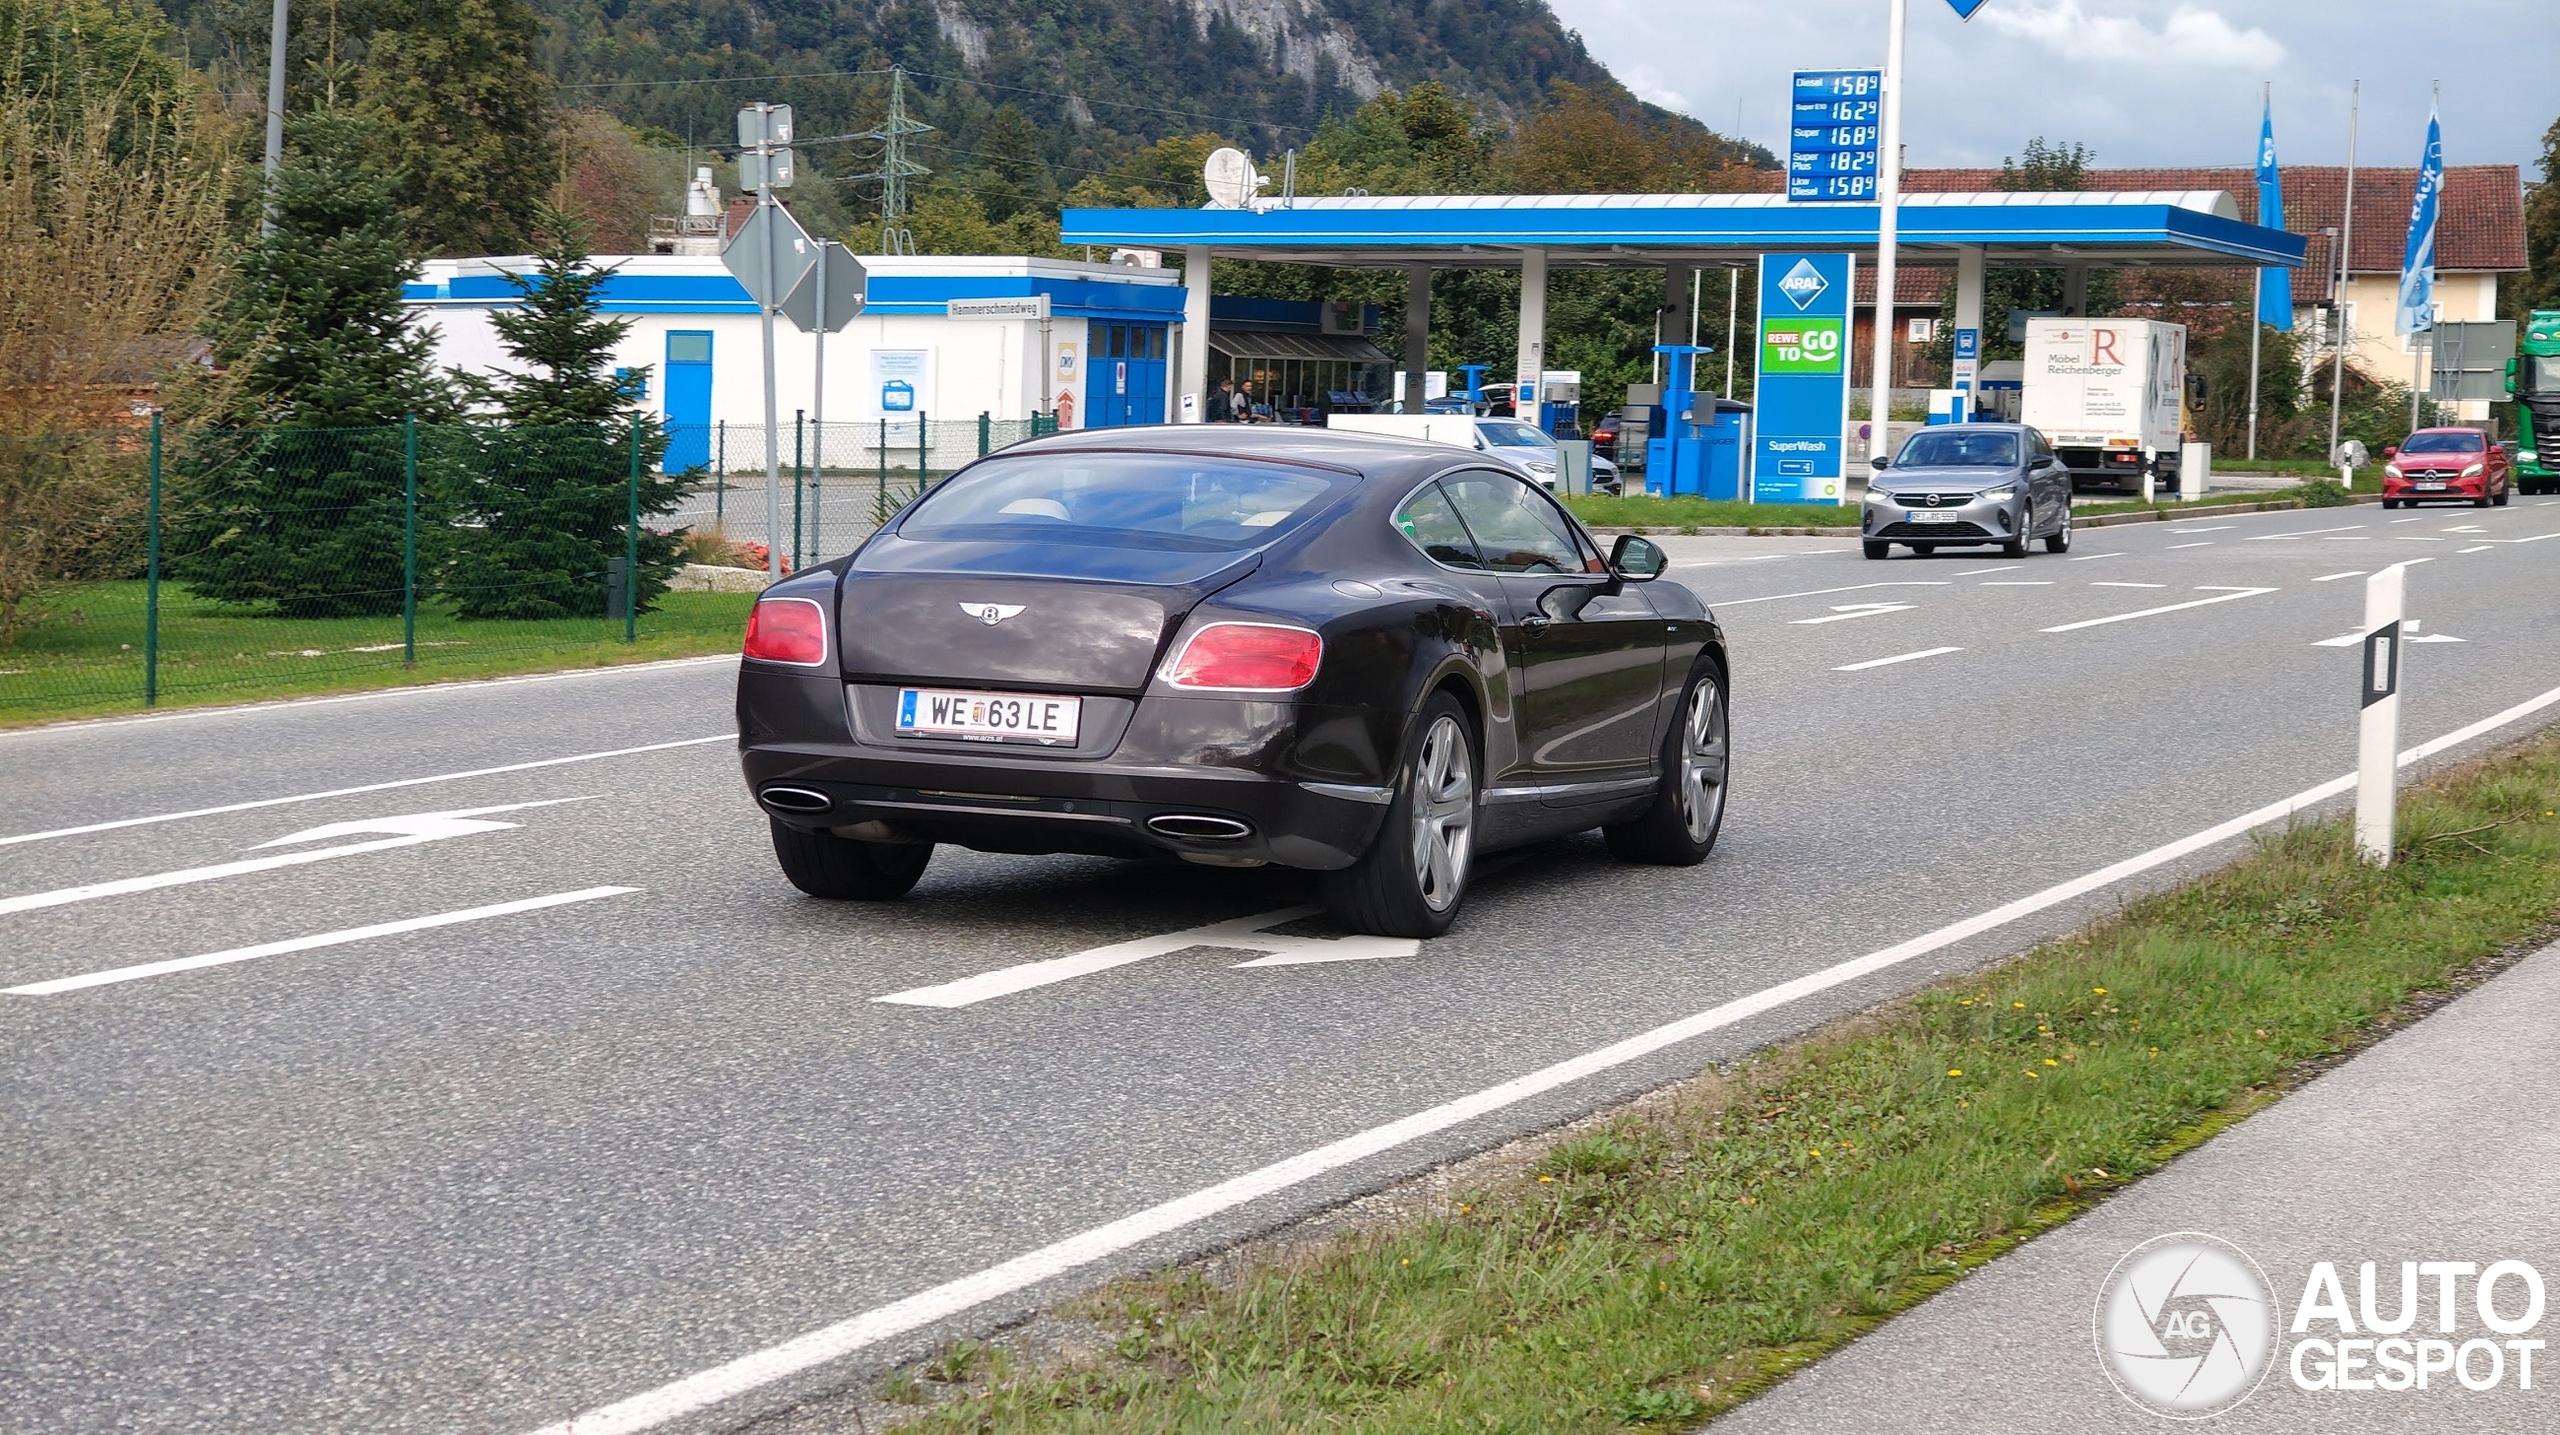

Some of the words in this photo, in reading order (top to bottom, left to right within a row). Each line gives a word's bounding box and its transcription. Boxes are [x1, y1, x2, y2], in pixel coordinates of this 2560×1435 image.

[1796, 78, 1823, 87] Diesel
[1794, 128, 1820, 138] Super
[1792, 153, 1819, 162] Super
[1792, 162, 1812, 170] Plus
[1791, 187, 1818, 196] Diesel
[1785, 278, 1821, 289] ARAL
[952, 302, 1037, 316] Hammerschmiedweg
[1768, 334, 1799, 343] REWE
[1802, 331, 1838, 350] GO
[2091, 329, 2126, 366] R
[1777, 347, 1801, 361] TO
[2048, 365, 2122, 377] Reichenberger
[1769, 441, 1826, 452] SuperWash
[932, 697, 967, 726] WE
[904, 714, 912, 723] A
